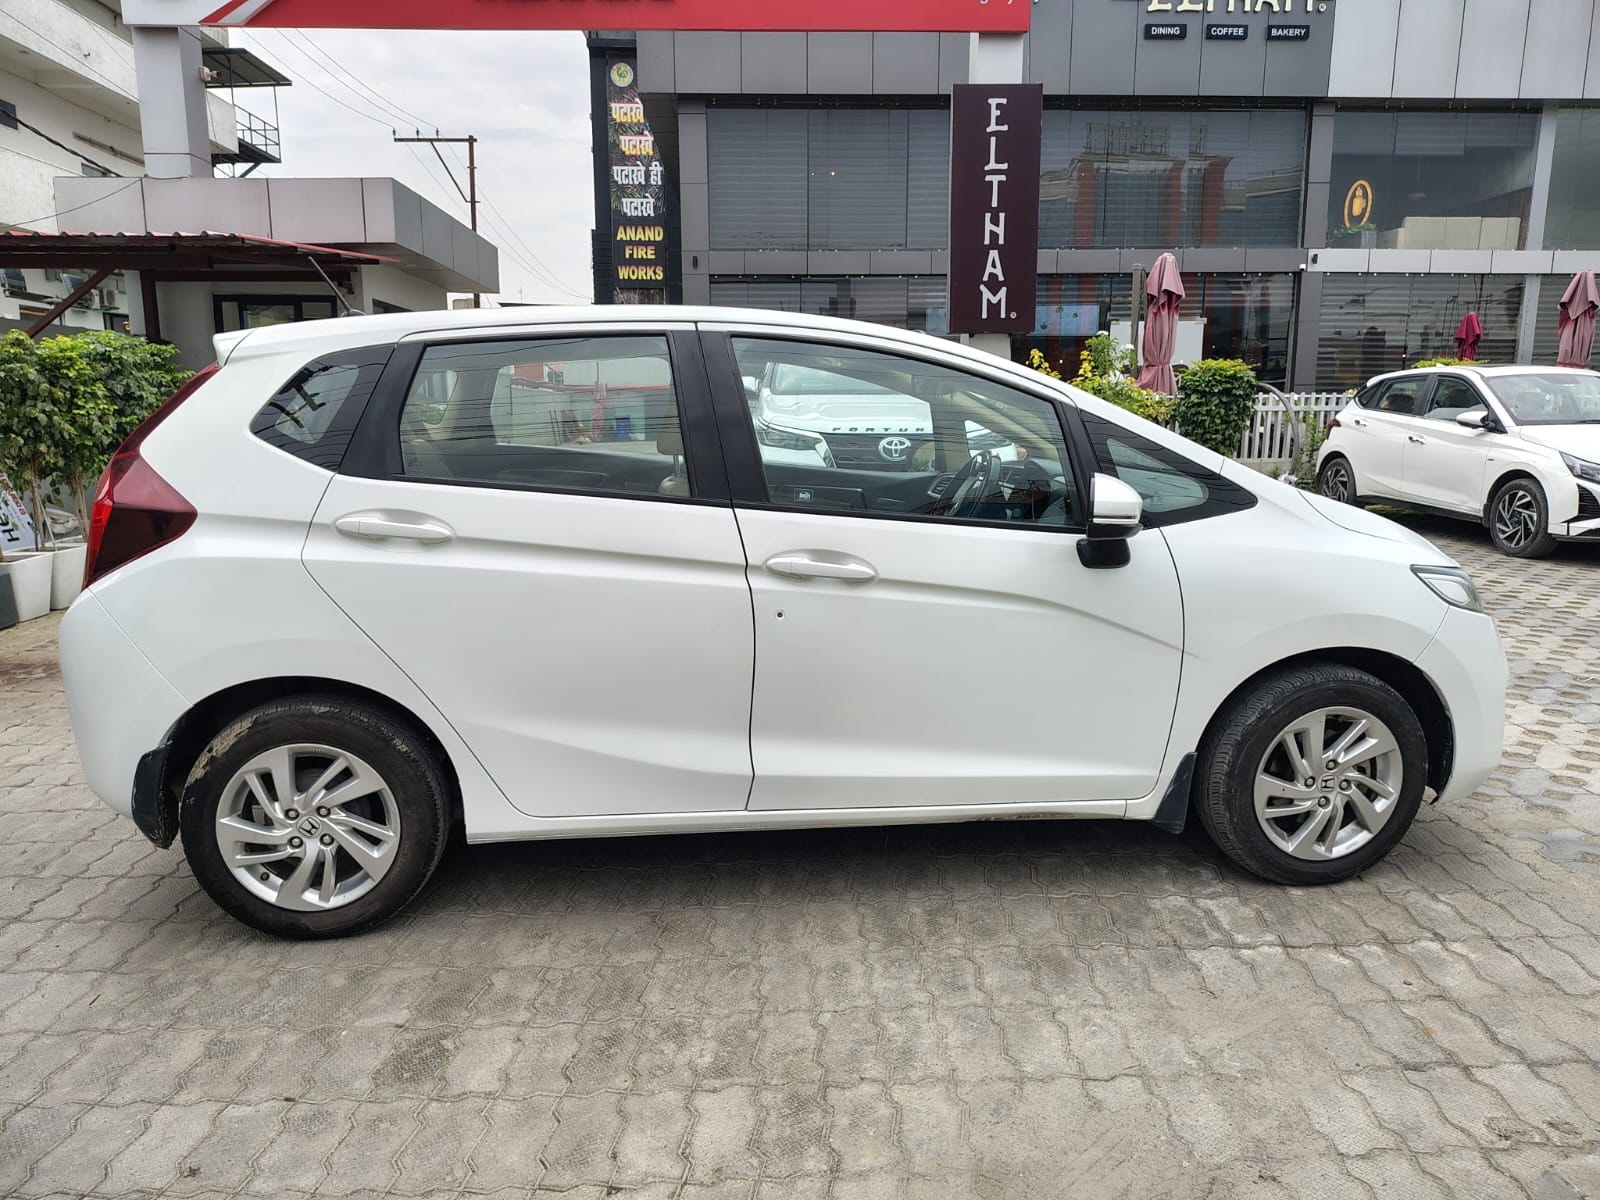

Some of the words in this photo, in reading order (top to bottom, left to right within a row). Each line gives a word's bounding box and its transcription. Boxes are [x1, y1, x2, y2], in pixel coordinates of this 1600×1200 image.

[1151, 26, 1180, 35] DINING
[1211, 27, 1244, 36] COFFEE
[1271, 28, 1306, 37] BAKERY
[611, 98, 644, 123] पटाखे
[619, 131, 654, 155] पटाखे
[612, 161, 646, 185] पटाखे
[649, 161, 663, 185] ही
[621, 193, 655, 217] पटाखे
[616, 225, 664, 241] ANAND
[625, 245, 656, 259] FIRE
[617, 265, 664, 281] WORKS
